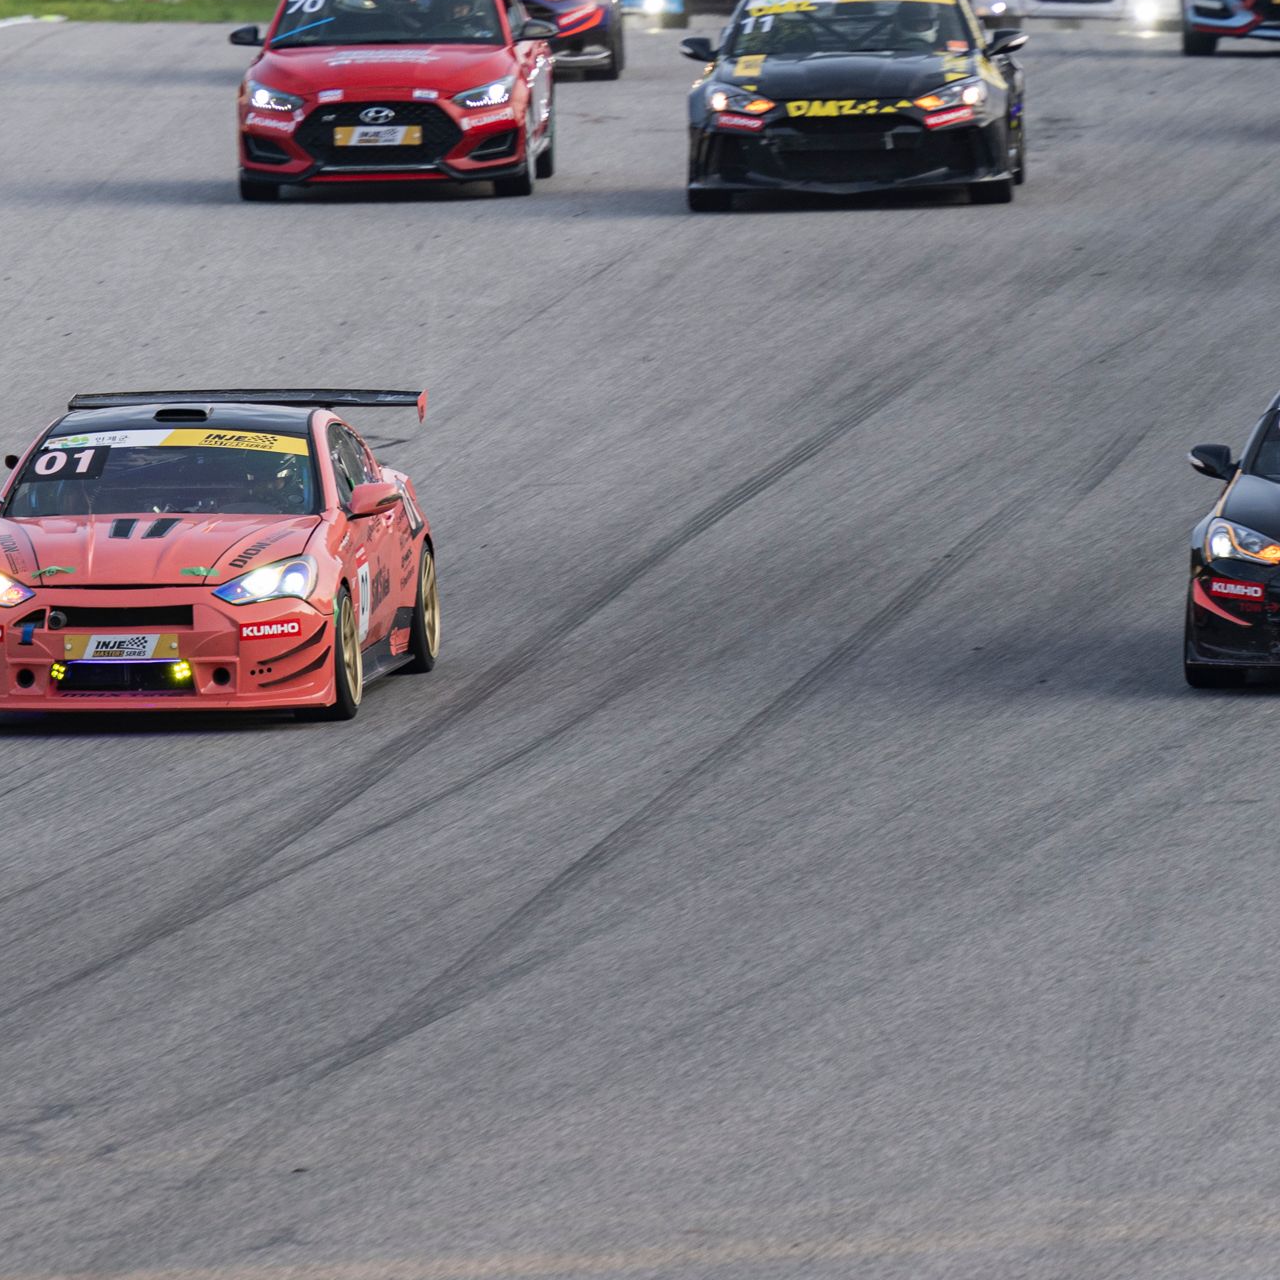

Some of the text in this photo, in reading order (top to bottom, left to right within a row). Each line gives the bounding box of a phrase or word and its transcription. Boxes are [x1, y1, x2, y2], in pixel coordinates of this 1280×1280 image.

[741, 15, 775, 34] 11
[785, 100, 860, 117] DMZ
[204, 433, 248, 441] INJE
[34, 449, 95, 476] 01
[228, 541, 272, 569] DION
[1212, 581, 1262, 597] KUMHO
[242, 622, 299, 637] KUMHO
[95, 640, 126, 649] INJE
